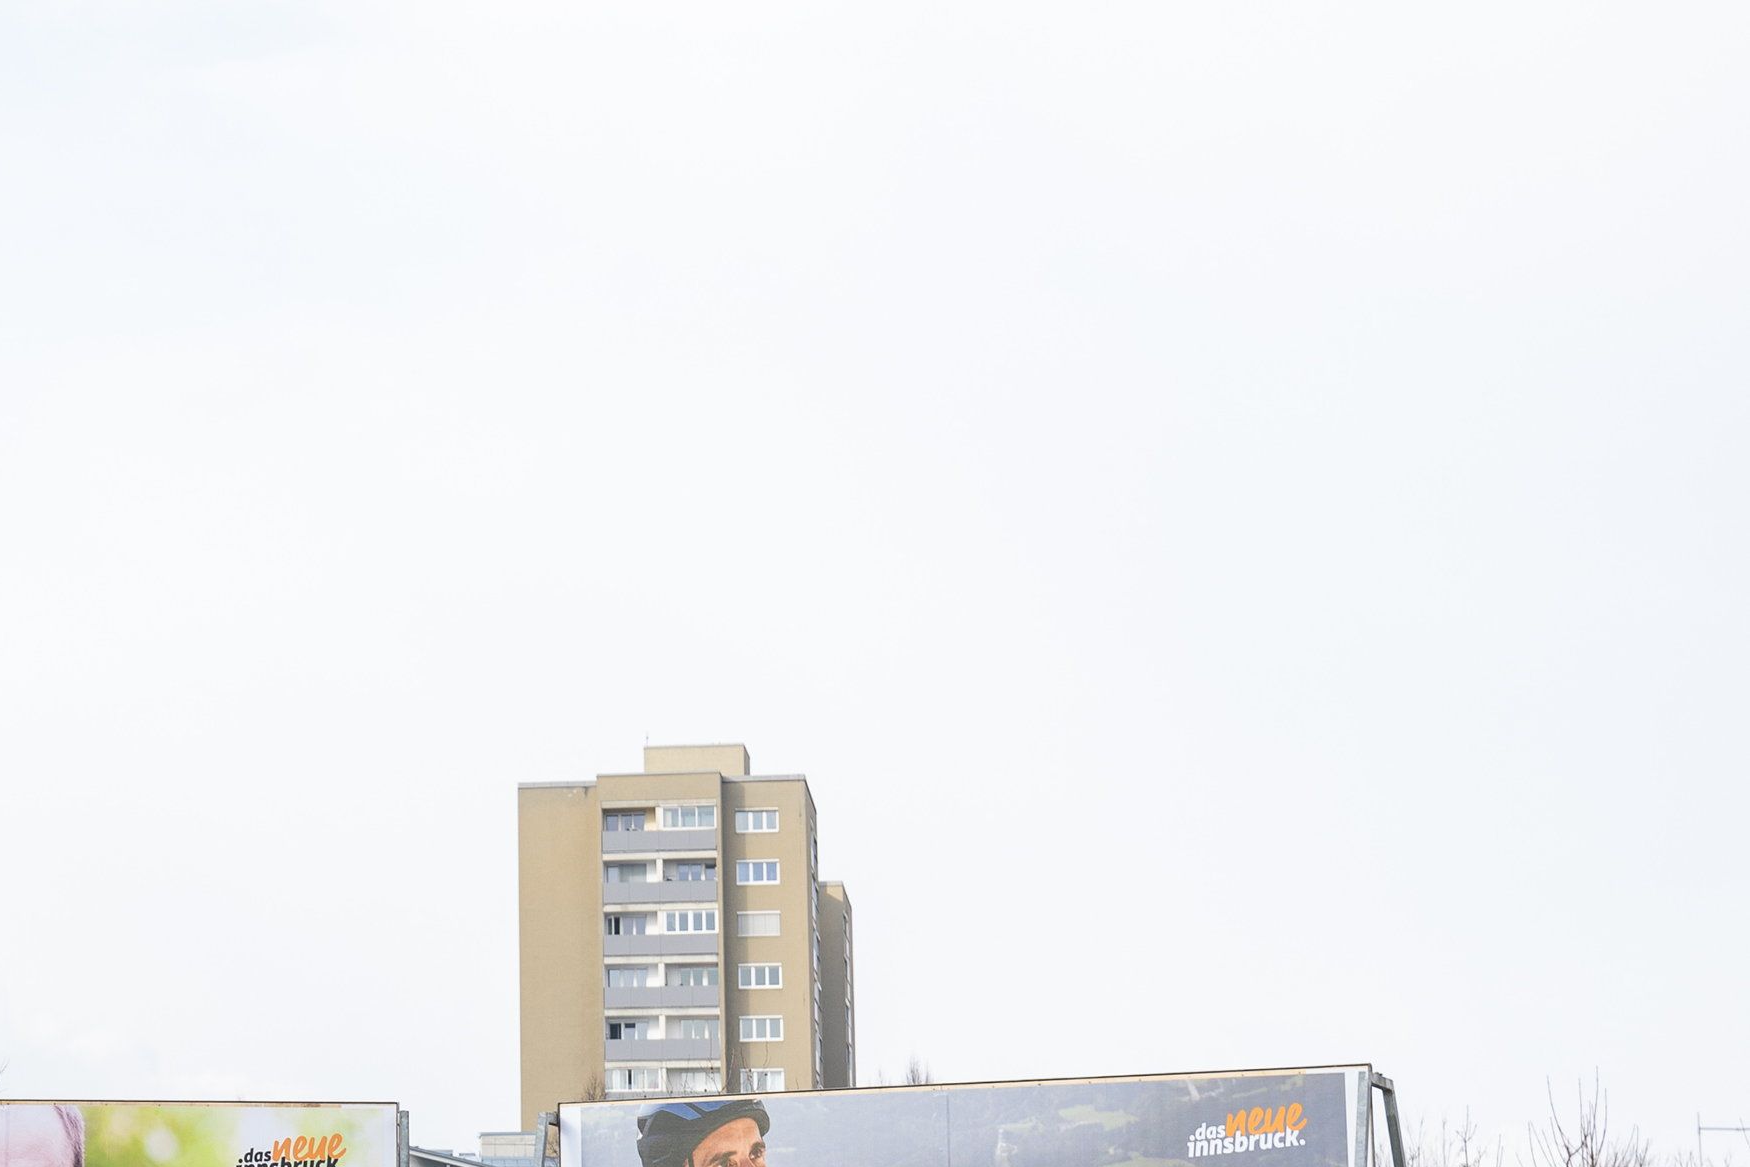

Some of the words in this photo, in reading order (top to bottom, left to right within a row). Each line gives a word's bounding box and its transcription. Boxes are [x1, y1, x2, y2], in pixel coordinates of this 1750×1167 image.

[1195, 1122, 1226, 1140] das
[1226, 1103, 1307, 1137] neue
[244, 1148, 272, 1162] das
[272, 1133, 347, 1161] neue
[1187, 1125, 1306, 1158] innsbruck.
